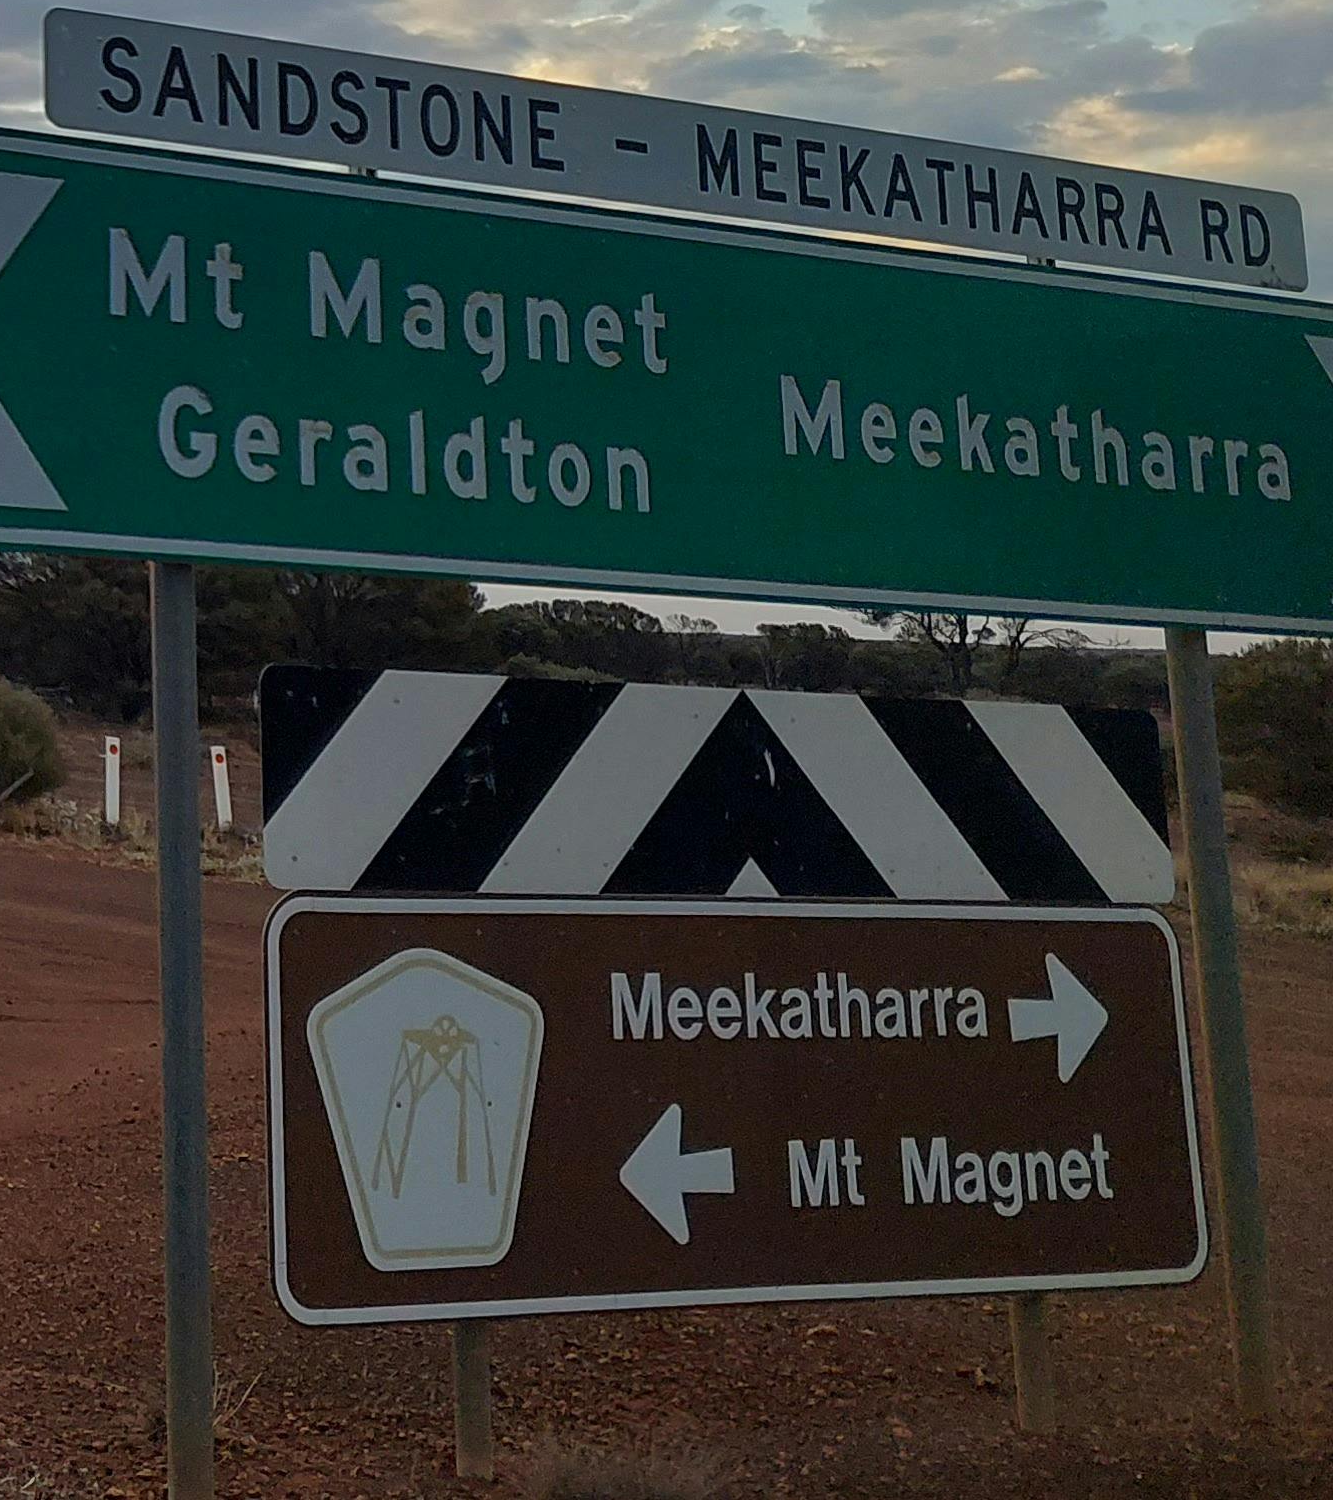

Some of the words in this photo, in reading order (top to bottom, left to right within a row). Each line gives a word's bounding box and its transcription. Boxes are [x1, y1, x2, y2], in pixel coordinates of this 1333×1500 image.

[99, 36, 566, 172] SANDSTONE
[696, 123, 1173, 256] MEEKATHARRA
[1199, 198, 1272, 268] RD
[109, 227, 244, 330] Mt
[309, 250, 668, 385] Magnet
[159, 385, 651, 513] Geraldton
[780, 374, 1292, 502] Meekatharra
[610, 971, 988, 1041] Meekatharra
[787, 1137, 866, 1208] Mt
[900, 1133, 1114, 1217] Magnet
